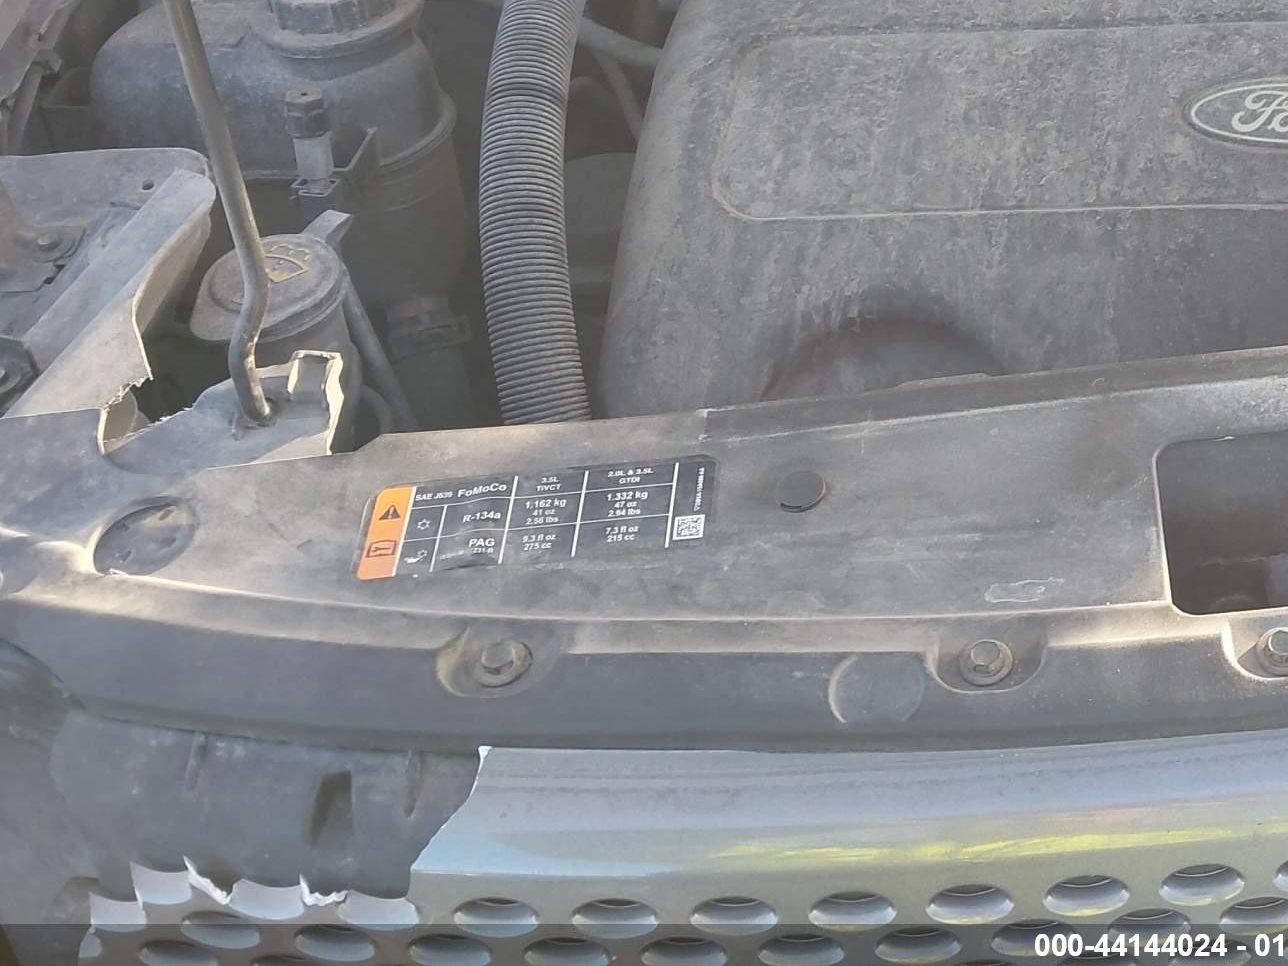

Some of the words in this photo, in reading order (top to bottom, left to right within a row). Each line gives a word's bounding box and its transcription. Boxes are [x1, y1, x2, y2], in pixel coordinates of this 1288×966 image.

[457, 483, 508, 498] FoMoCo
[415, 493, 433, 502] SAE
[607, 492, 633, 501] 1.332
[635, 491, 648, 500] kg
[525, 499, 551, 509] 1.162
[553, 498, 567, 508] kg
[462, 511, 501, 522] R-134a
[608, 509, 626, 517] 2.94
[606, 526, 618, 534] 7.3
[468, 538, 496, 547] PAG
[523, 543, 540, 551] 275
